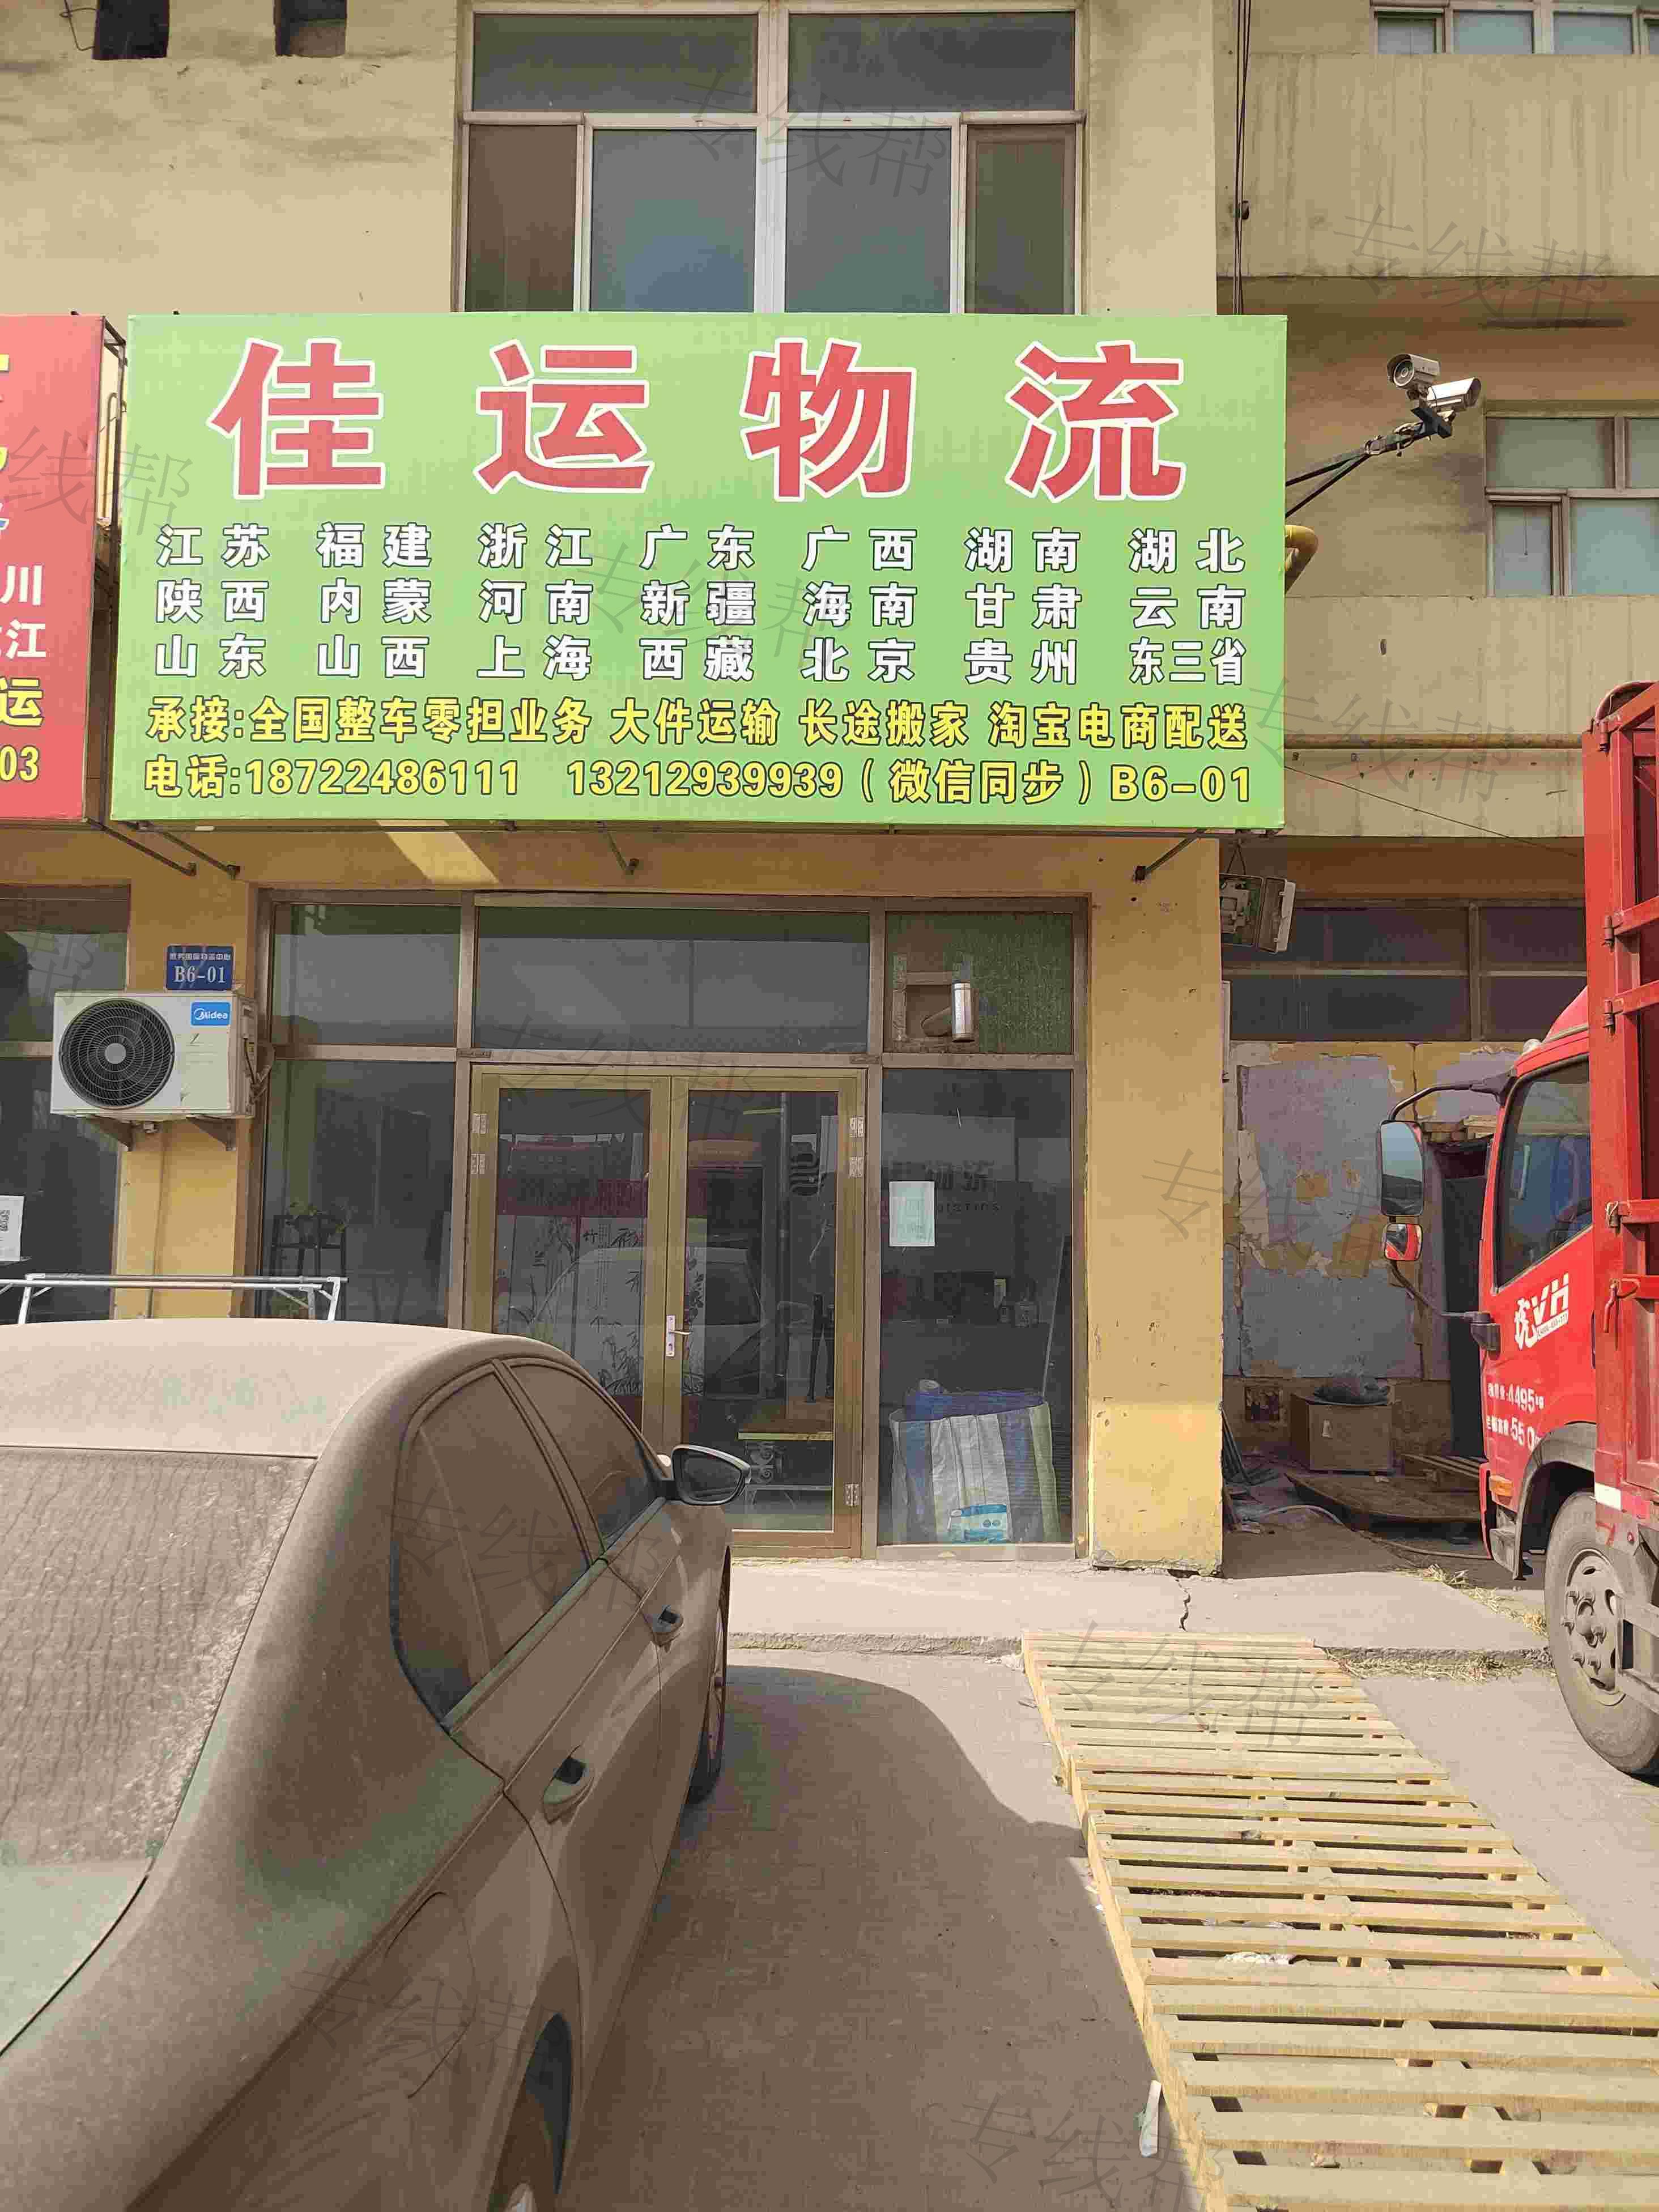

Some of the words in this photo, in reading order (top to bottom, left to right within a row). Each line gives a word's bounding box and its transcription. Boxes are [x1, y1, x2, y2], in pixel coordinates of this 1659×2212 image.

[208, 336, 1186, 503] 佳运物流
[156, 523, 271, 568] 江苏
[316, 521, 432, 571] 福建
[477, 522, 593, 568] 浙江
[639, 523, 755, 571] 广东
[801, 525, 917, 572] 广西
[964, 526, 1081, 573] 湖南
[1128, 528, 1245, 573] 湖北
[156, 577, 269, 623] 陕西
[318, 577, 431, 625] 内蒙
[479, 578, 593, 626] 河南
[640, 580, 756, 626] 新疆
[802, 580, 917, 628] 海南
[965, 581, 1082, 629] 甘肃
[1130, 584, 1246, 629] 云南
[0, 619, 46, 660] 江
[155, 632, 266, 680] 山东
[317, 634, 429, 679] 山西
[477, 634, 592, 680] 上海
[638, 635, 754, 682] 西藏
[800, 635, 915, 683] 北京
[964, 638, 1078, 686] 贵州
[1129, 636, 1247, 685] 东三省
[146, 695, 592, 744] 承接:全国整车零担业务
[610, 697, 780, 746] 大件运输
[798, 698, 969, 748] 长途搬家
[988, 700, 1248, 750] 淘宝电商配送
[0, 745, 40, 781] 03
[144, 752, 517, 798] 电话:18722486111
[173, 965, 227, 983] B6-01
[194, 1008, 228, 1020] Midea
